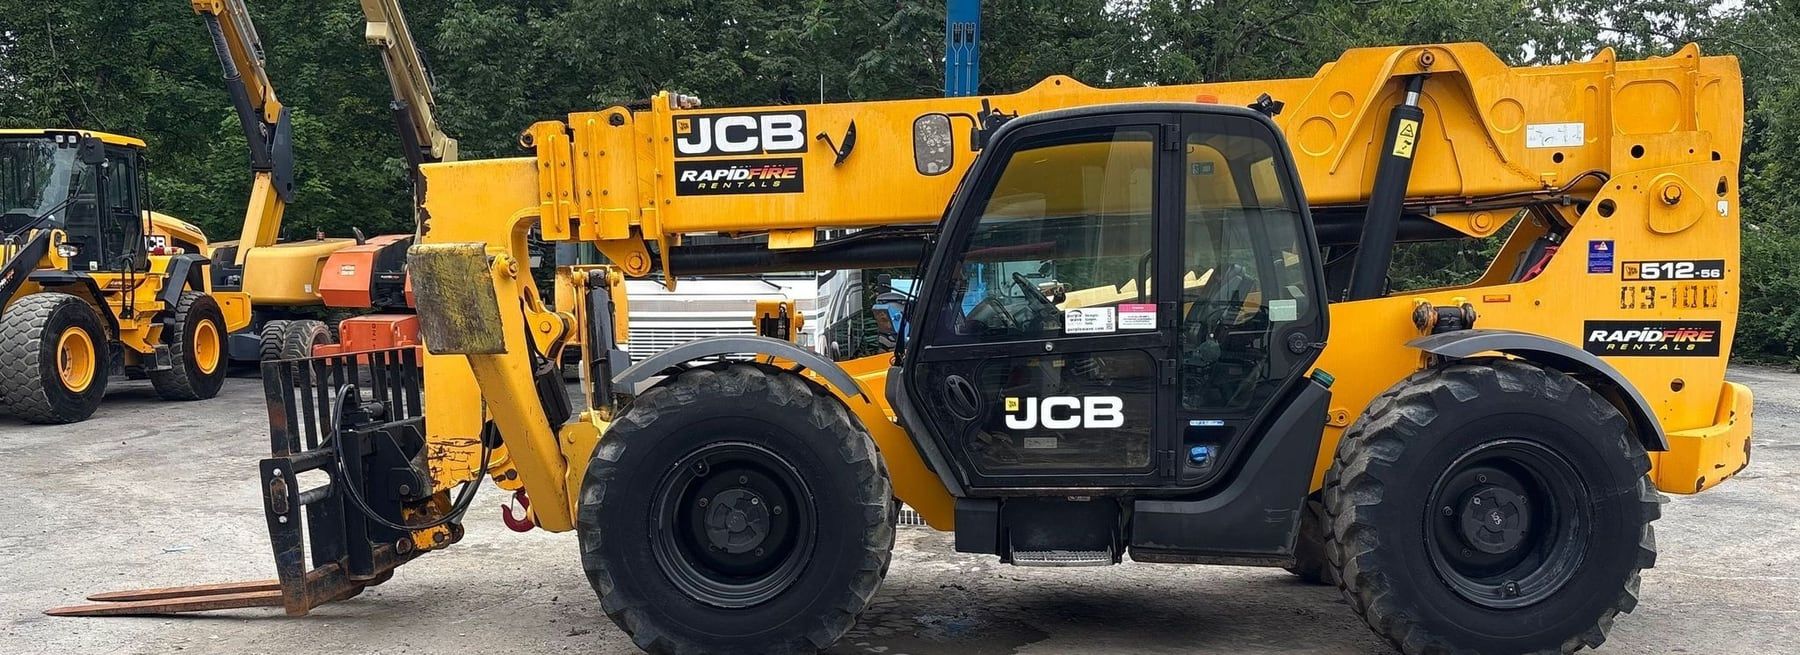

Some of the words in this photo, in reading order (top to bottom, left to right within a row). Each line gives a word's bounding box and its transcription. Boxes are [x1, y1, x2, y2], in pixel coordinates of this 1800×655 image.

[676, 114, 805, 154] JCB
[698, 181, 782, 190] RENTALS
[1641, 262, 1721, 280] 512-56
[1606, 343, 1696, 351] RENTALS
[1005, 396, 1124, 429] JCB
